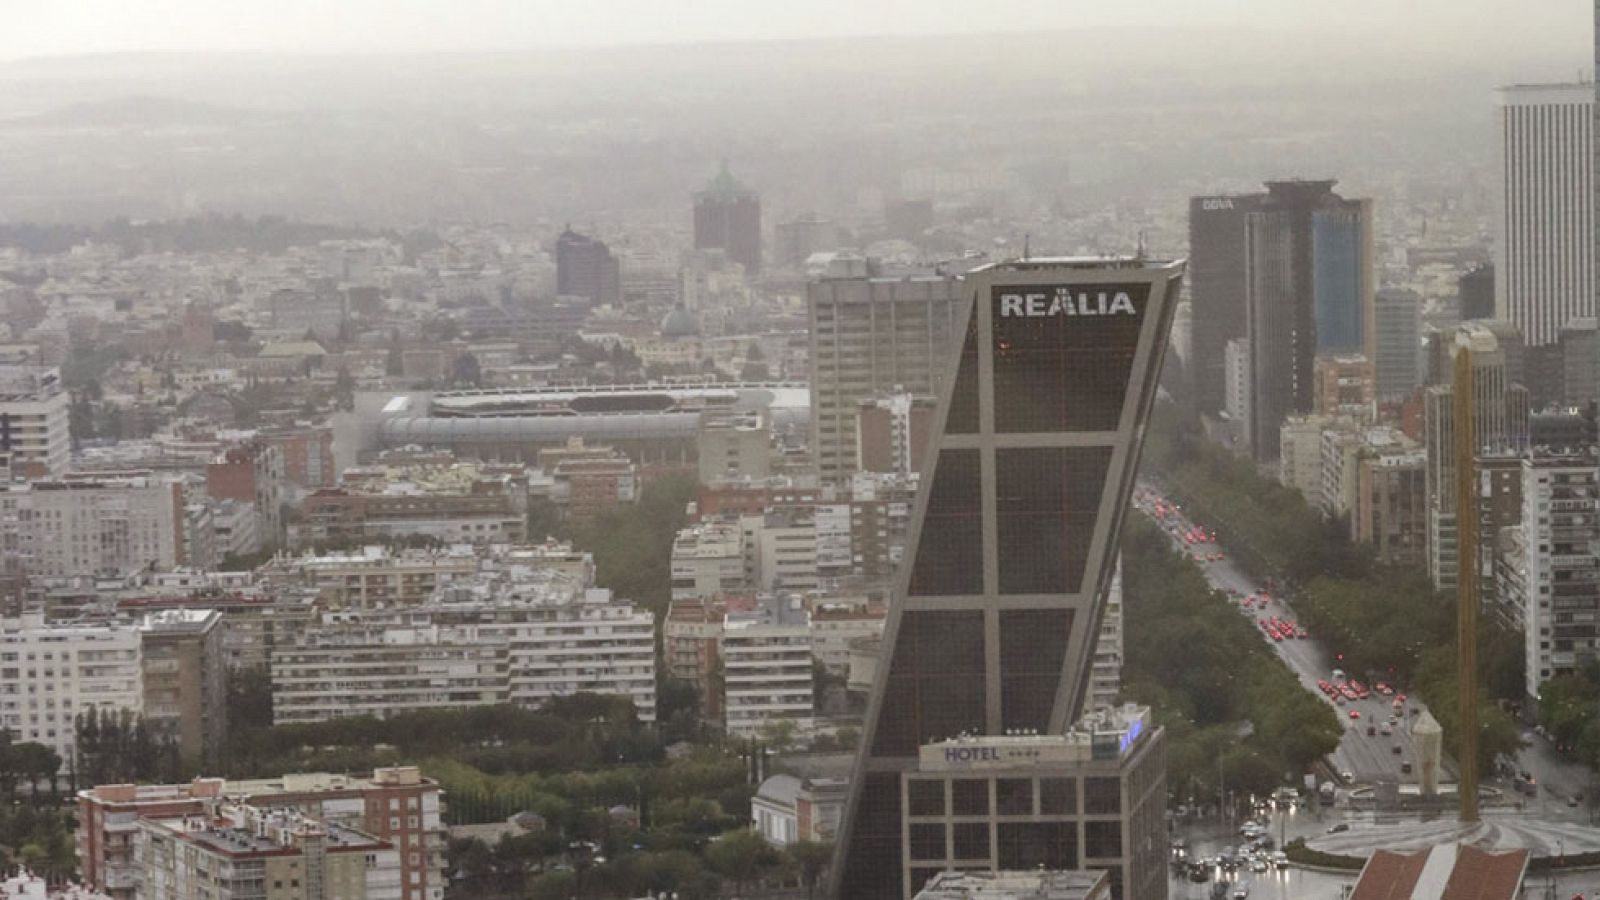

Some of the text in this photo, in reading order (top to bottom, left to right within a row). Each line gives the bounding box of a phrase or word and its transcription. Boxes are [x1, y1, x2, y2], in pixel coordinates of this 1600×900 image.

[1202, 198, 1235, 210] BBVA
[1000, 289, 1136, 317] REALIA
[945, 747, 1000, 761] HOTEL
